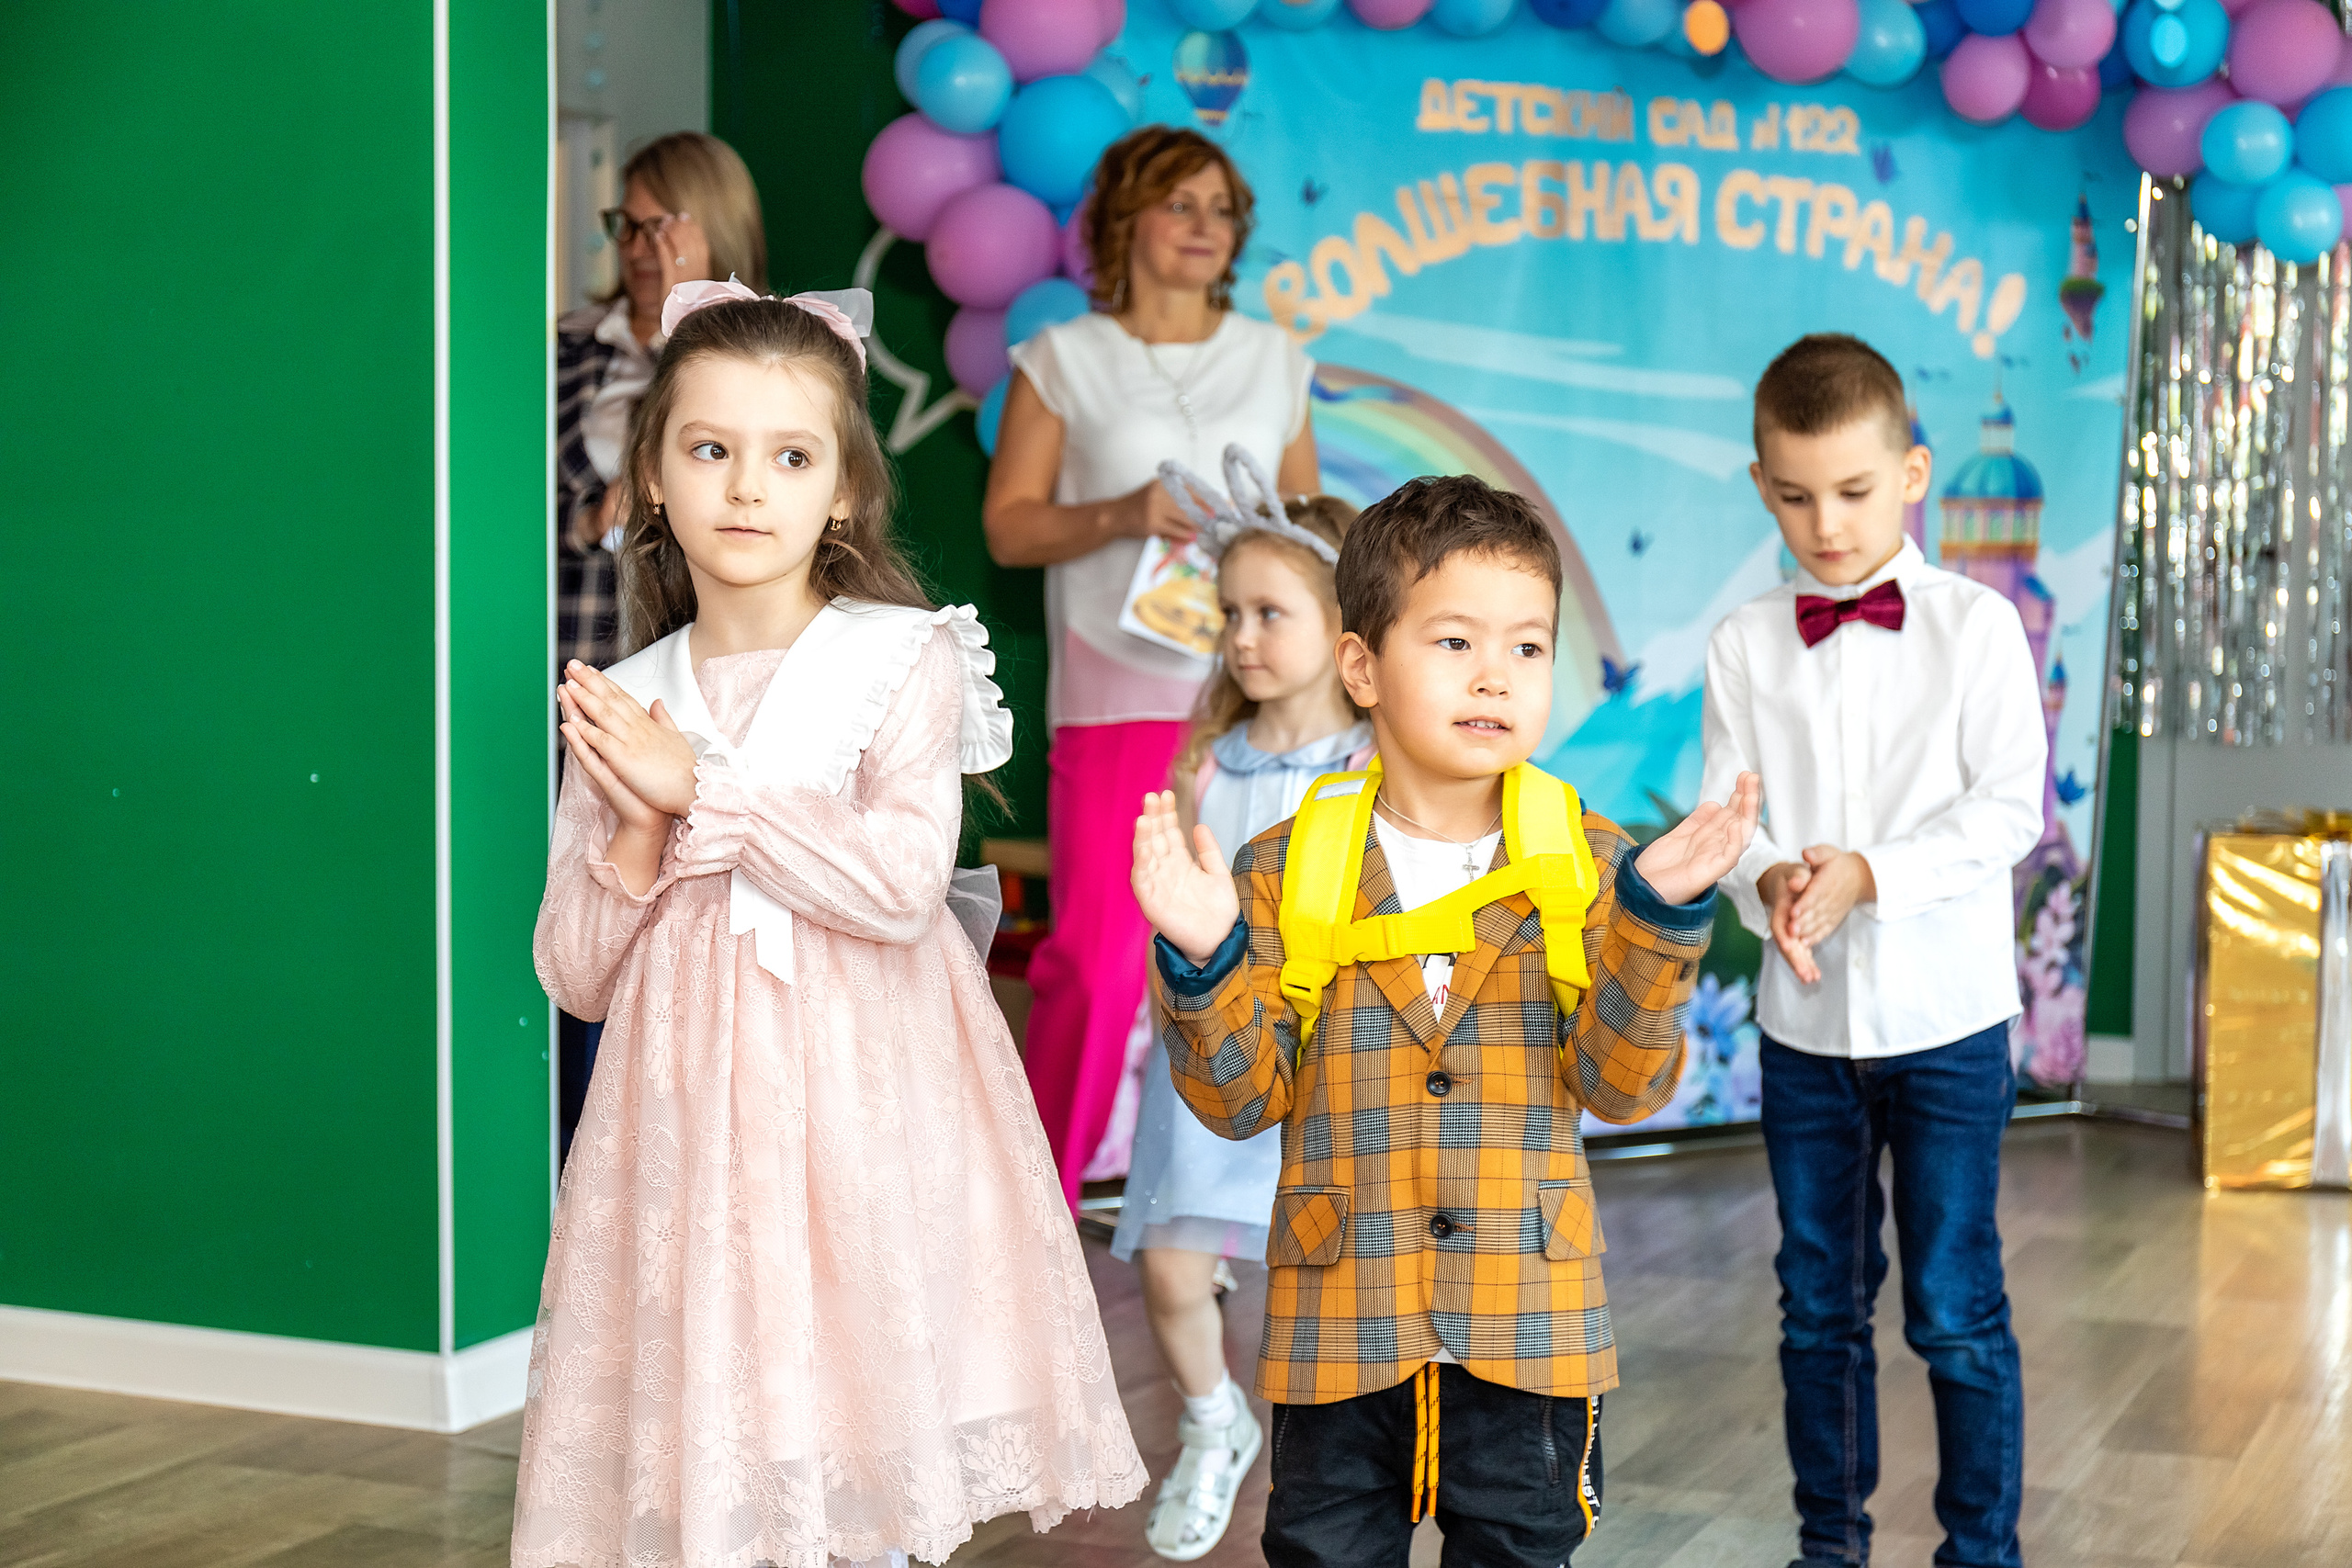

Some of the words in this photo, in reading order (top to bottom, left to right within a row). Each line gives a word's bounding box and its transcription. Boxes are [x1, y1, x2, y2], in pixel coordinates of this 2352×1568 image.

[1416, 78, 1633, 141] ДЕТСКИЙ
[1647, 96, 1739, 152] САД
[1263, 160, 1700, 345] ВОЛШЕБНАЯ
[1715, 168, 2027, 359] СТРАНА!
